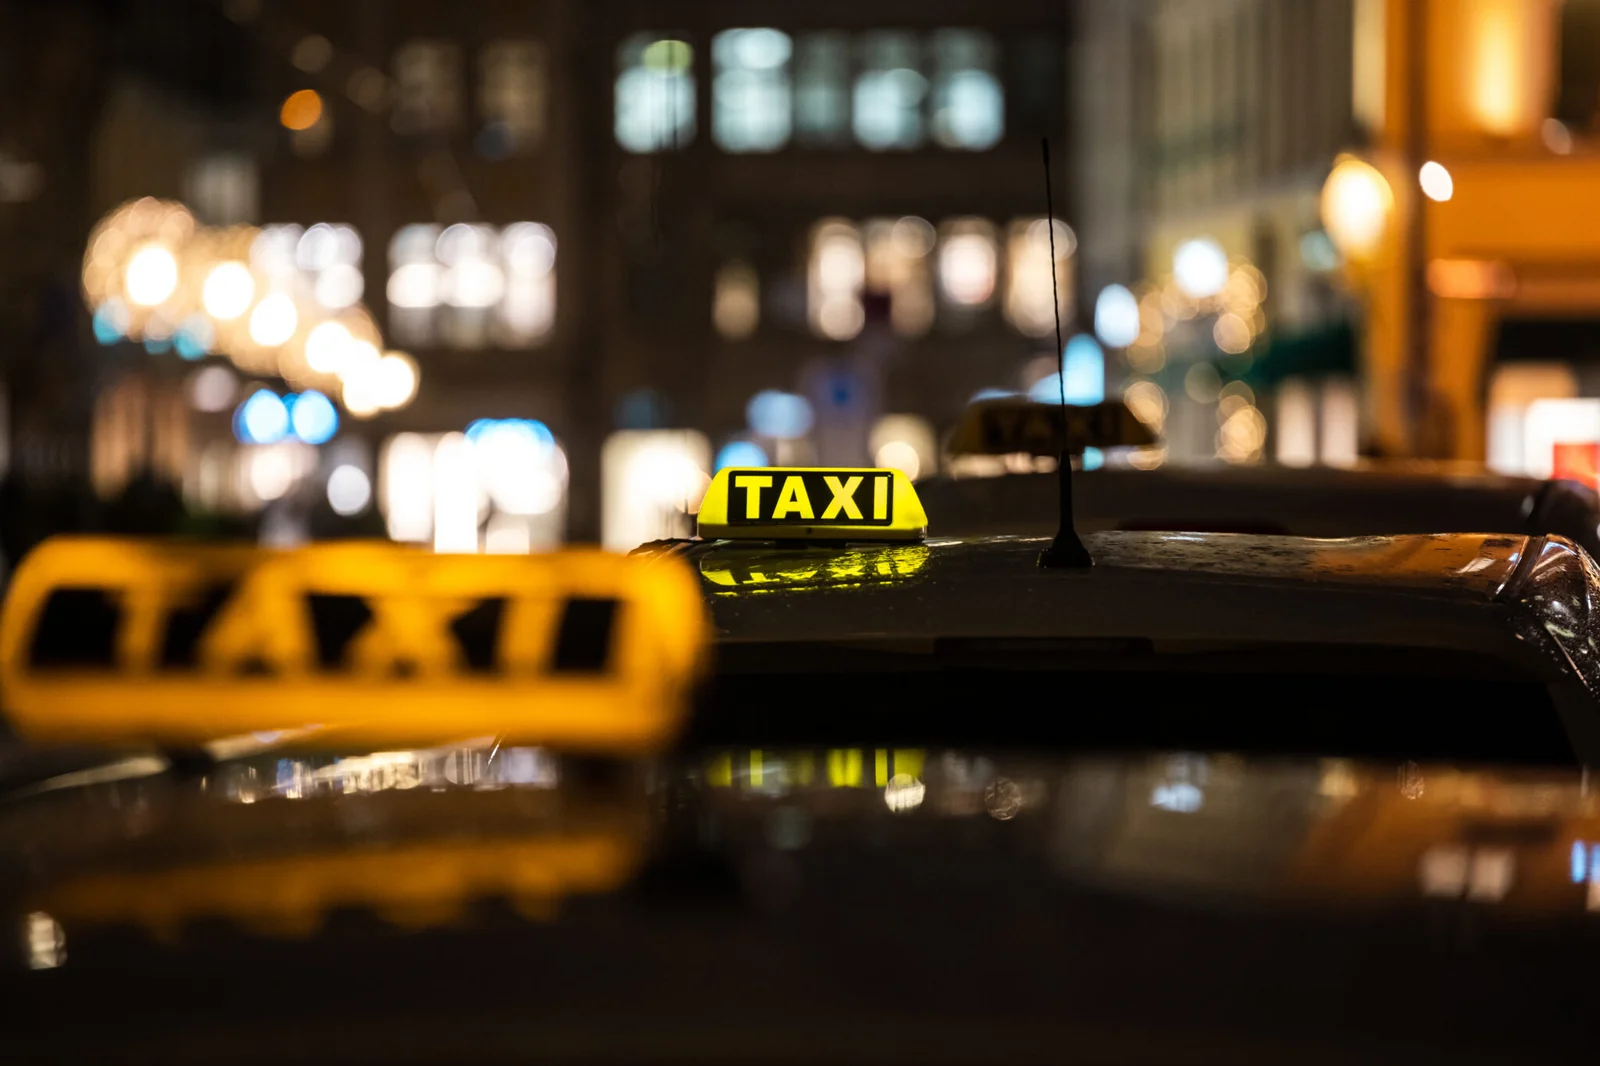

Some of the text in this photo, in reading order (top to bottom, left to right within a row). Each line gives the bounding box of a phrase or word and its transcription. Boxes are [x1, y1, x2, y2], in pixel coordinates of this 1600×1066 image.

[991, 407, 1113, 444] TAXI
[734, 475, 889, 520] TAXI
[46, 578, 572, 675] TAXI
